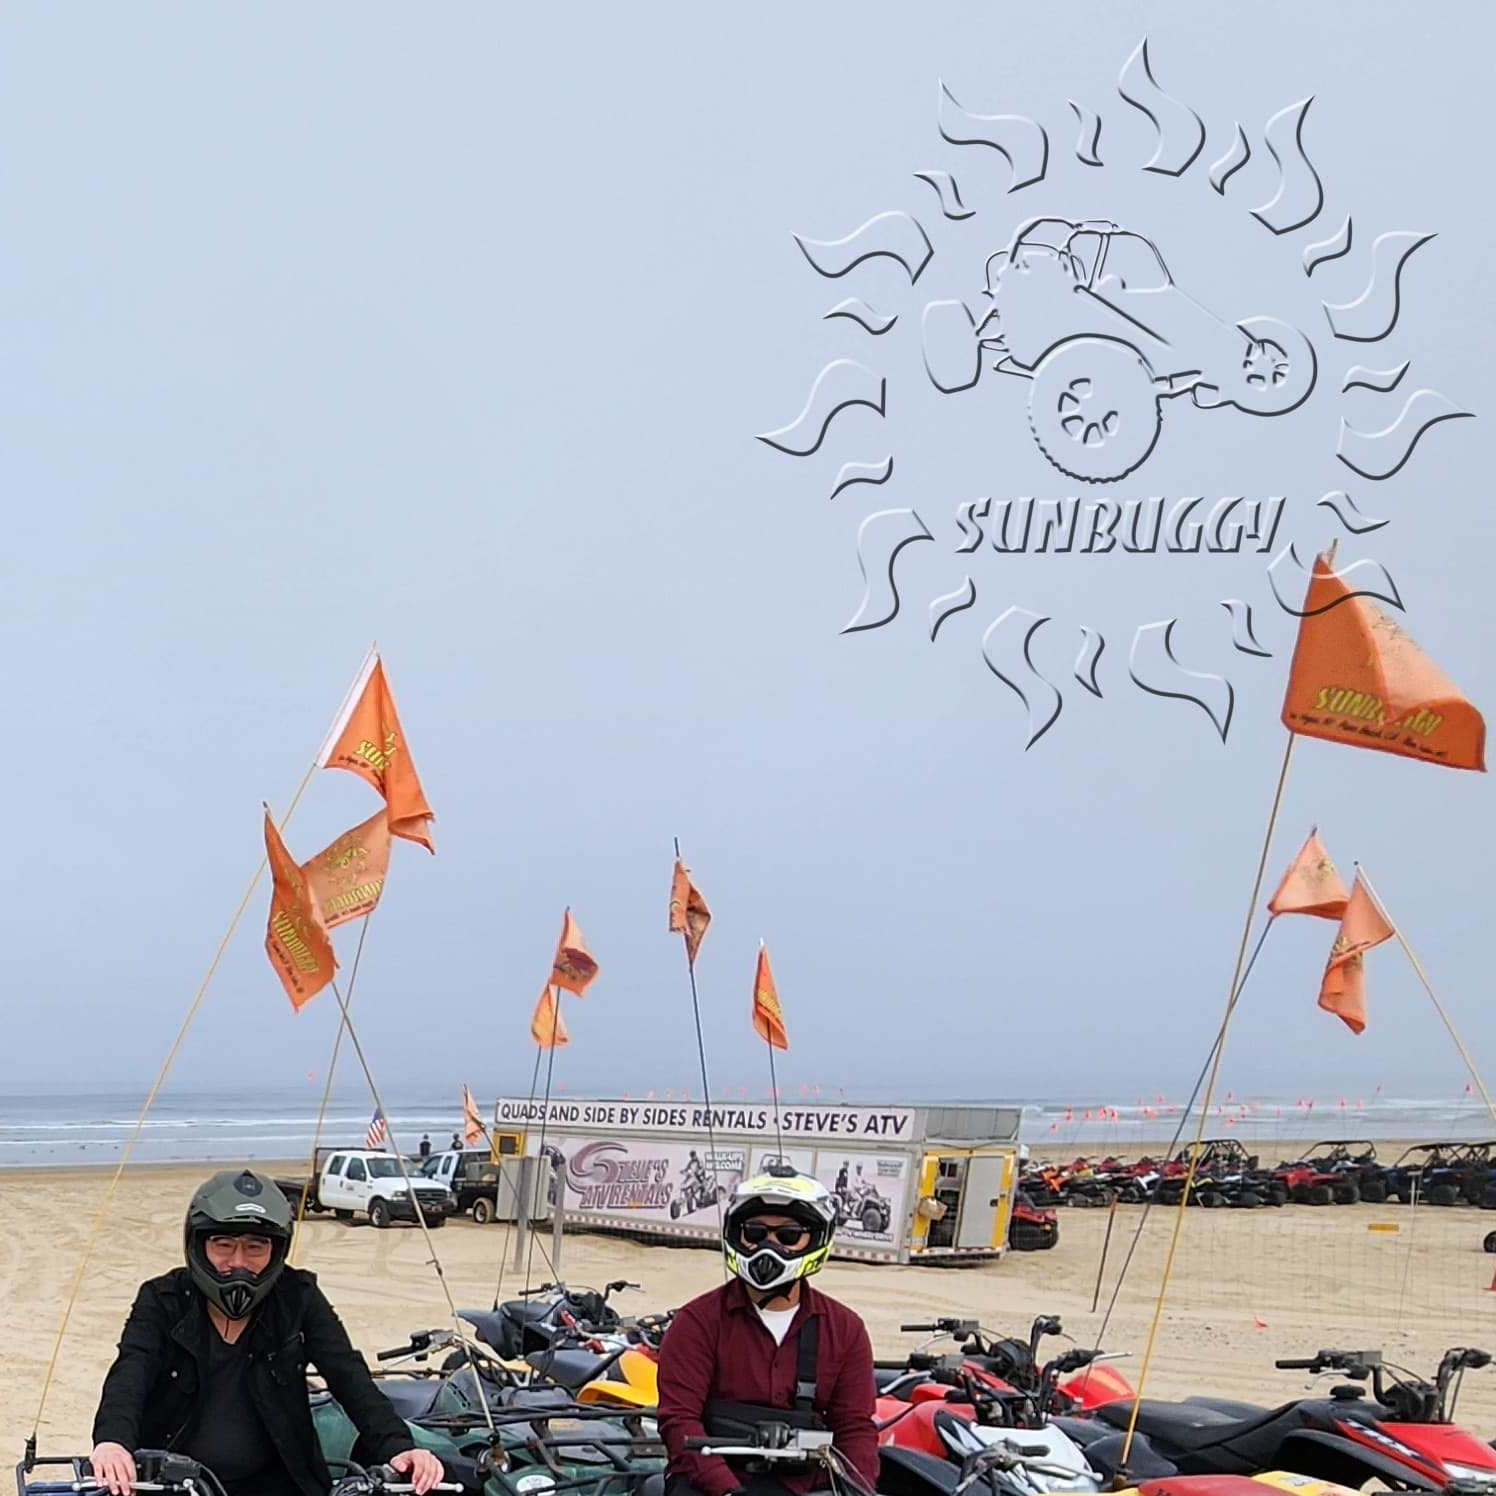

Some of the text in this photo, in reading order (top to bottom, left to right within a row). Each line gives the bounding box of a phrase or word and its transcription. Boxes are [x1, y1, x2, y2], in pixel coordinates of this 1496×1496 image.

[501, 1104, 908, 1134] QUADS AND SIDE BY SIDES RENTALS STEVE'S ATV
